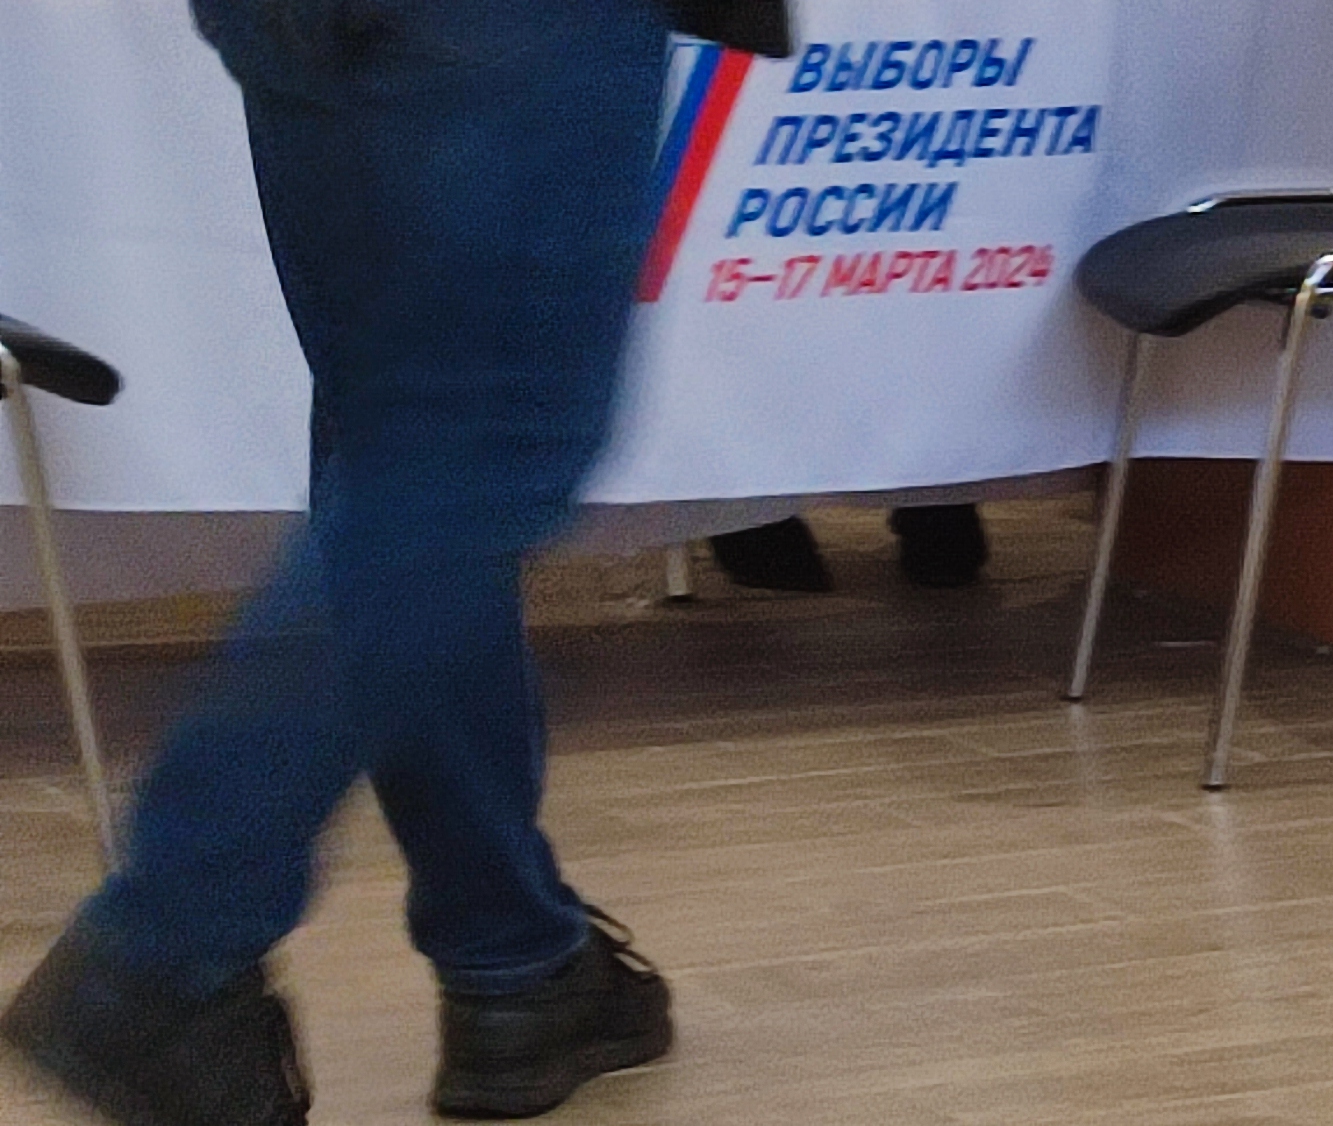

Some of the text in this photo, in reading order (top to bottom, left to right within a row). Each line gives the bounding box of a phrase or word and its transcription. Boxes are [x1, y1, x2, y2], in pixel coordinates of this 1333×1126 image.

[788, 38, 1036, 93] ВЫБОРЫ
[754, 105, 1102, 168] ПРЕЗИДЕНТА
[726, 181, 958, 238] РОССИИ
[820, 249, 957, 297] МАРТА
[960, 245, 1055, 291] 2024
